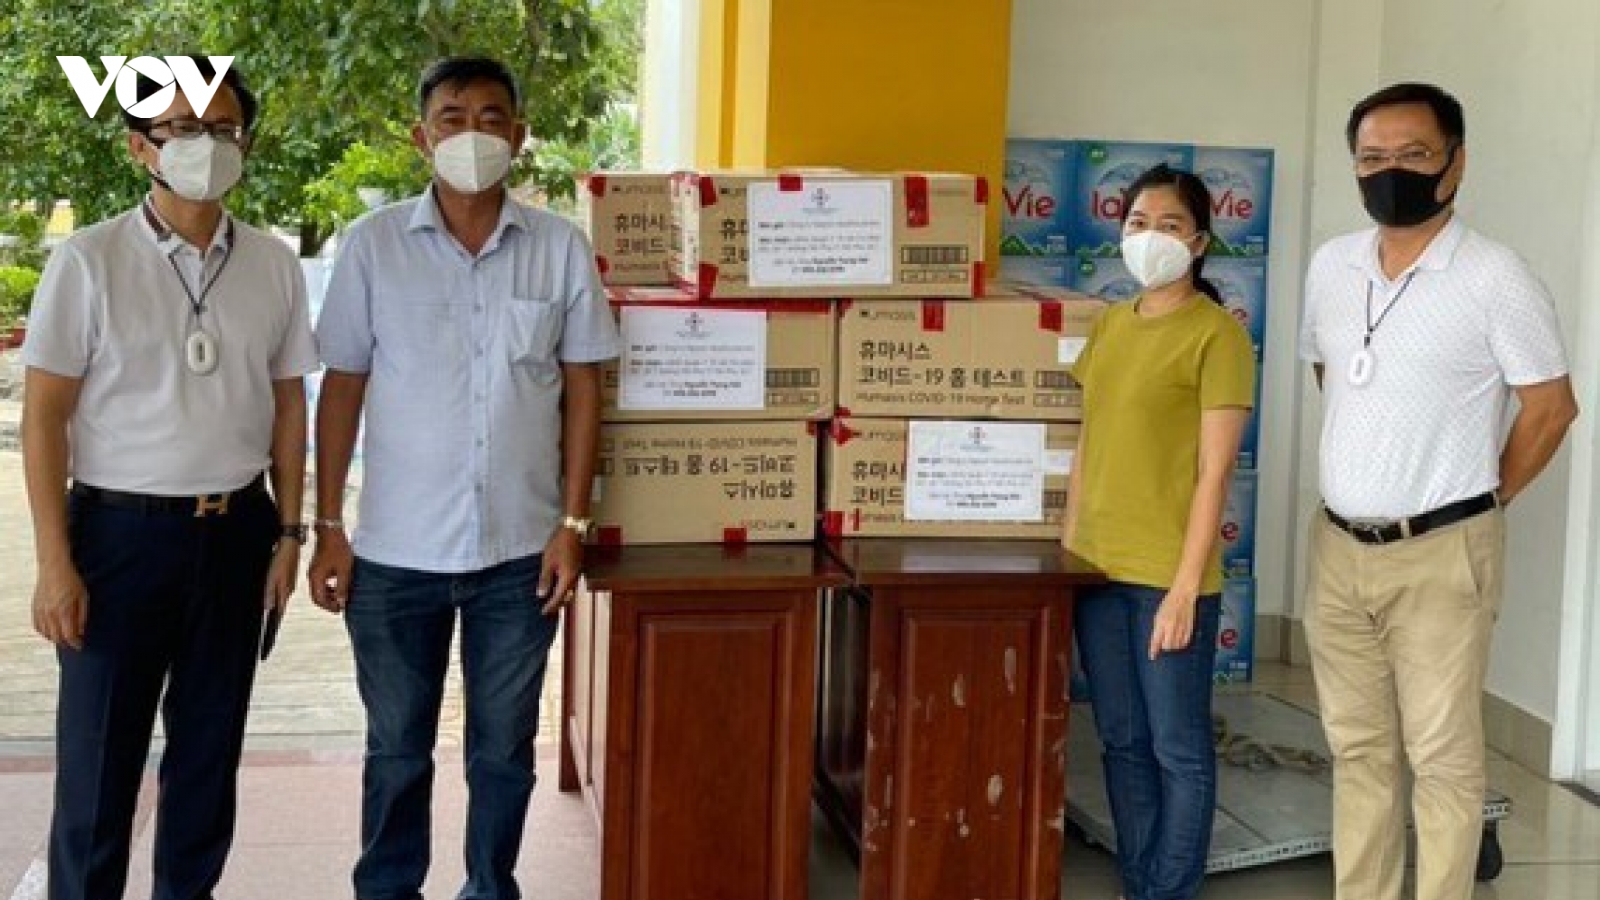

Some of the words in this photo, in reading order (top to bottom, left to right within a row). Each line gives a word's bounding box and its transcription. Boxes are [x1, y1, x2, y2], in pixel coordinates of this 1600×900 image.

[1002, 184, 1055, 219] Vie
[860, 340, 932, 361] 휴마시스
[857, 367, 944, 387] 코비드-19
[973, 370, 1025, 388] 테스트
